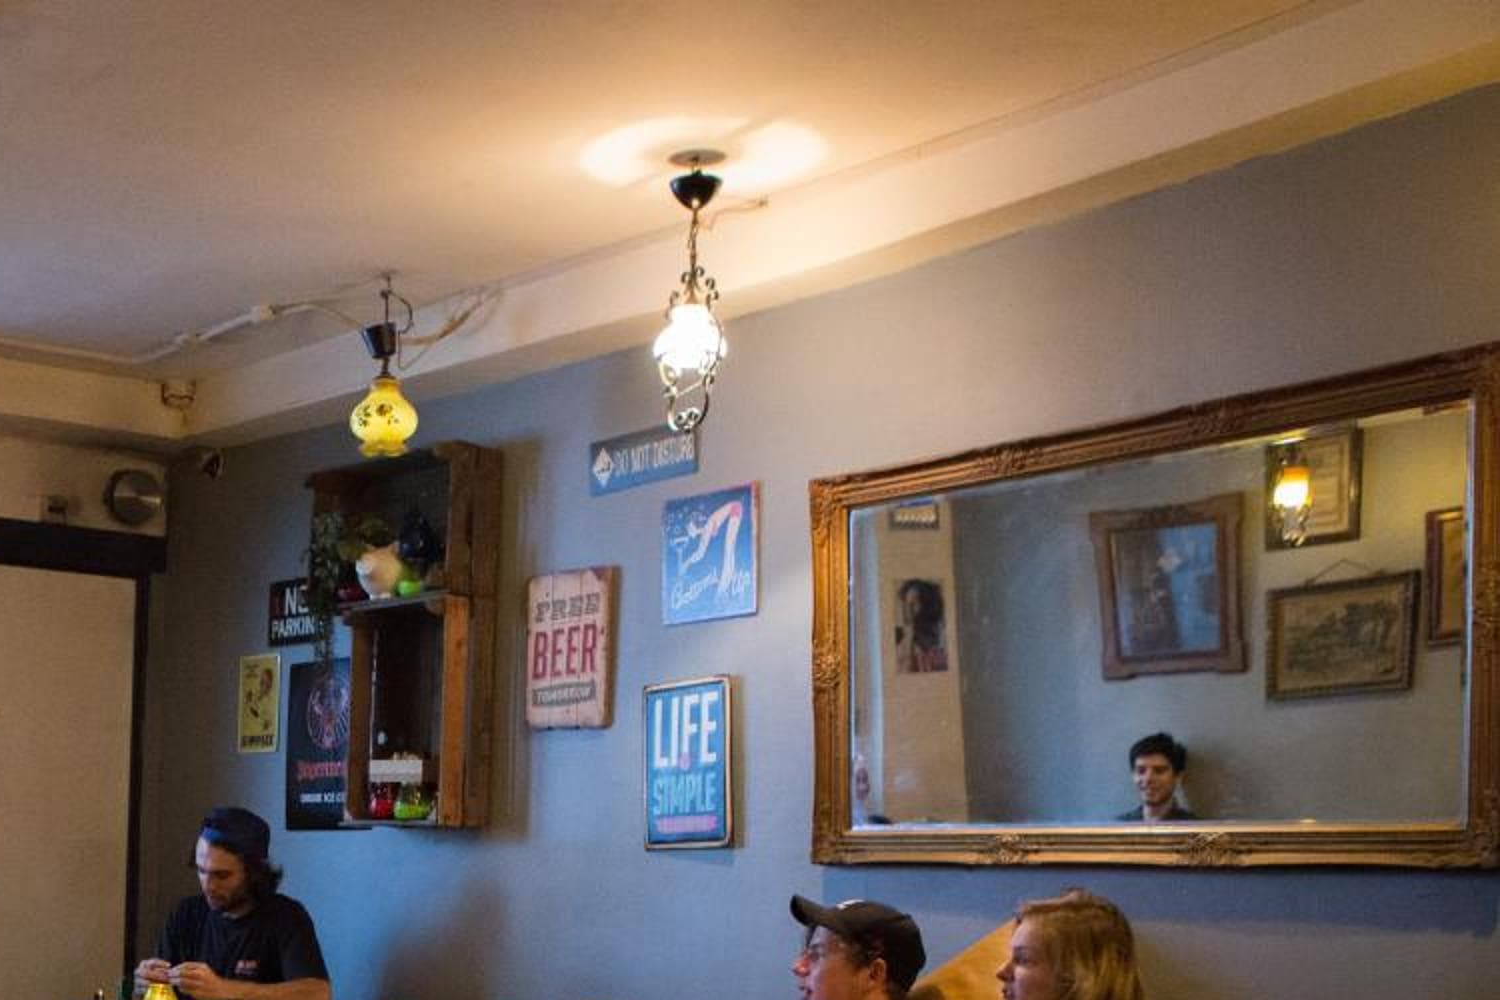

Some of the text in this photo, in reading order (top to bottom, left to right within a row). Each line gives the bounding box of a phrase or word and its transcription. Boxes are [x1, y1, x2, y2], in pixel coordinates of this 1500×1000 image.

[630, 443, 650, 474] NOT
[534, 592, 599, 623] FREE
[271, 615, 318, 640] PARKIN
[532, 622, 596, 680] BEER
[654, 691, 718, 768] LIFE
[653, 771, 716, 815] SIMPLE
